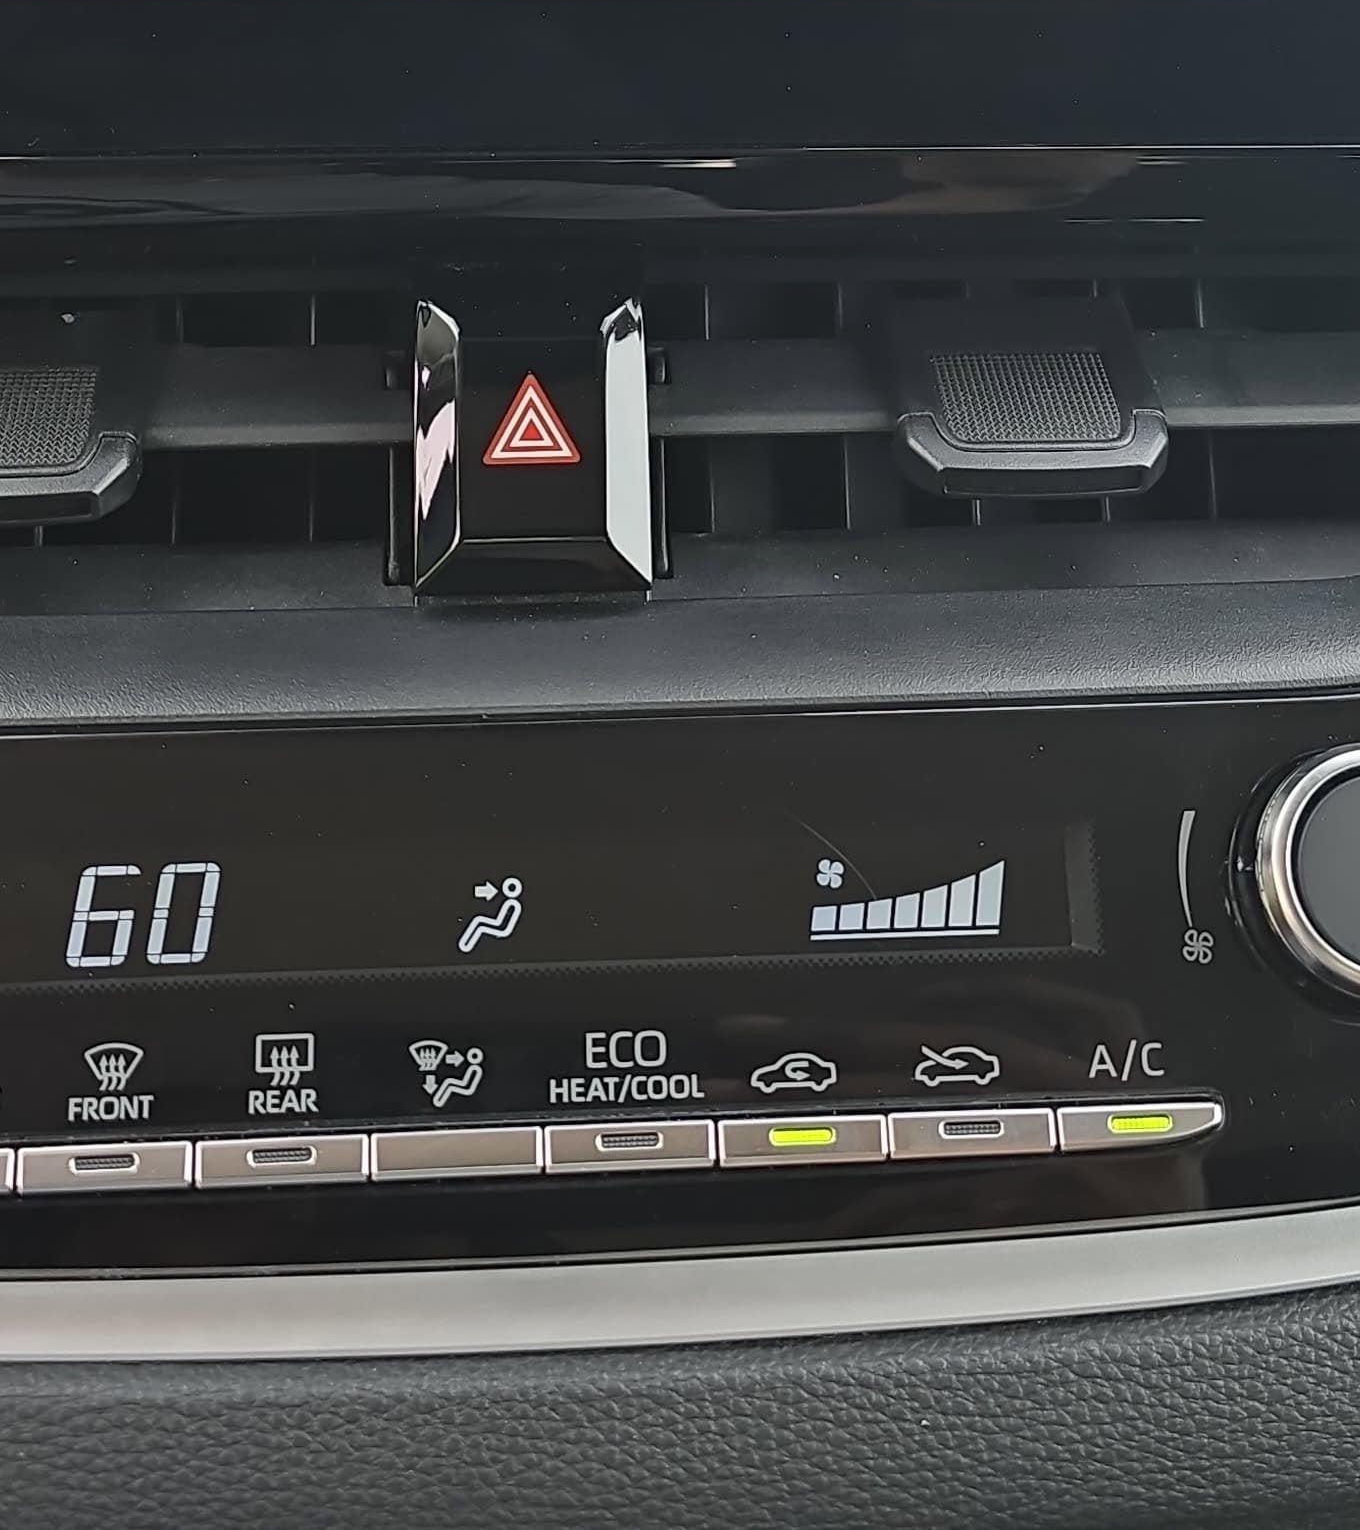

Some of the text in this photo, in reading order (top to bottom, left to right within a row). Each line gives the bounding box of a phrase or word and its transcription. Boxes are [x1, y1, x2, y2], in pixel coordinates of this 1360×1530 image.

[66, 862, 221, 968] 60
[585, 1029, 667, 1069] ECO
[1088, 1039, 1165, 1082] A/C
[248, 1088, 319, 1115] REAR
[549, 1073, 705, 1104] HEAT/COOL
[67, 1094, 155, 1122] FRONT
